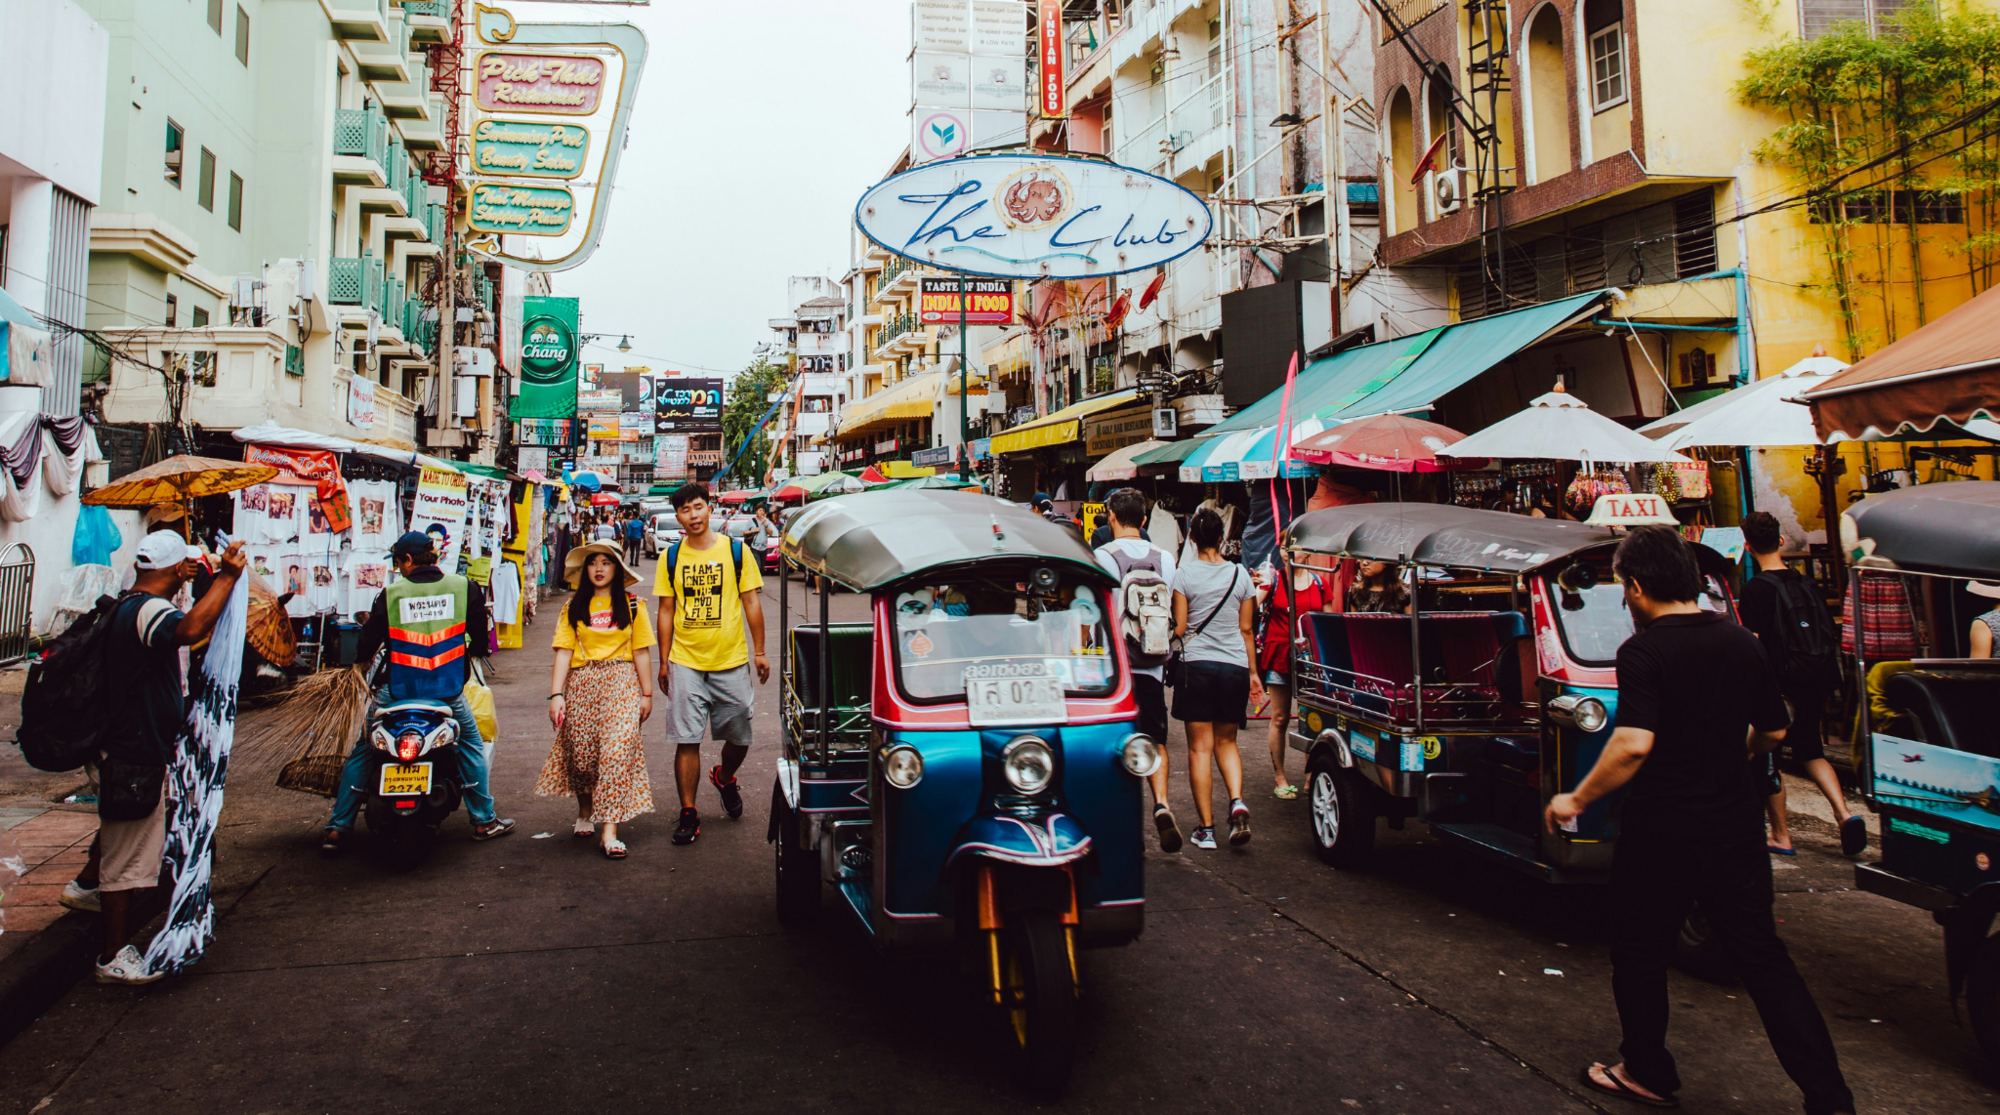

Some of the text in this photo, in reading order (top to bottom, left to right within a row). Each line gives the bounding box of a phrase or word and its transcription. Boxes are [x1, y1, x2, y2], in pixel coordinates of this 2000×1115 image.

[1046, 11, 1056, 65] INDIAN
[492, 83, 585, 106] Restaurant
[1048, 74, 1058, 110] FOOD
[476, 122, 584, 149] Swimming Pool
[480, 147, 575, 172] Beauty Salon
[476, 187, 571, 213] Thai Massage
[474, 205, 565, 228] Shopping Plaza
[898, 180, 1188, 252] The Club
[926, 282, 958, 292] TASTE
[976, 282, 1006, 292] INDIA
[974, 295, 1009, 311] FOOD
[522, 344, 568, 362] Chang
[1102, 424, 1112, 435] GOLF
[1114, 423, 1123, 433] BAR
[251, 449, 291, 465] Made
[298, 457, 316, 470] To
[422, 470, 440, 484] MADE
[442, 472, 450, 485] TO
[419, 493, 465, 506] Your Photo
[1607, 499, 1658, 517] TAXI
[698, 564, 713, 574] AM
[686, 574, 718, 586] ONE OF
[414, 610, 443, 618] 01-419
